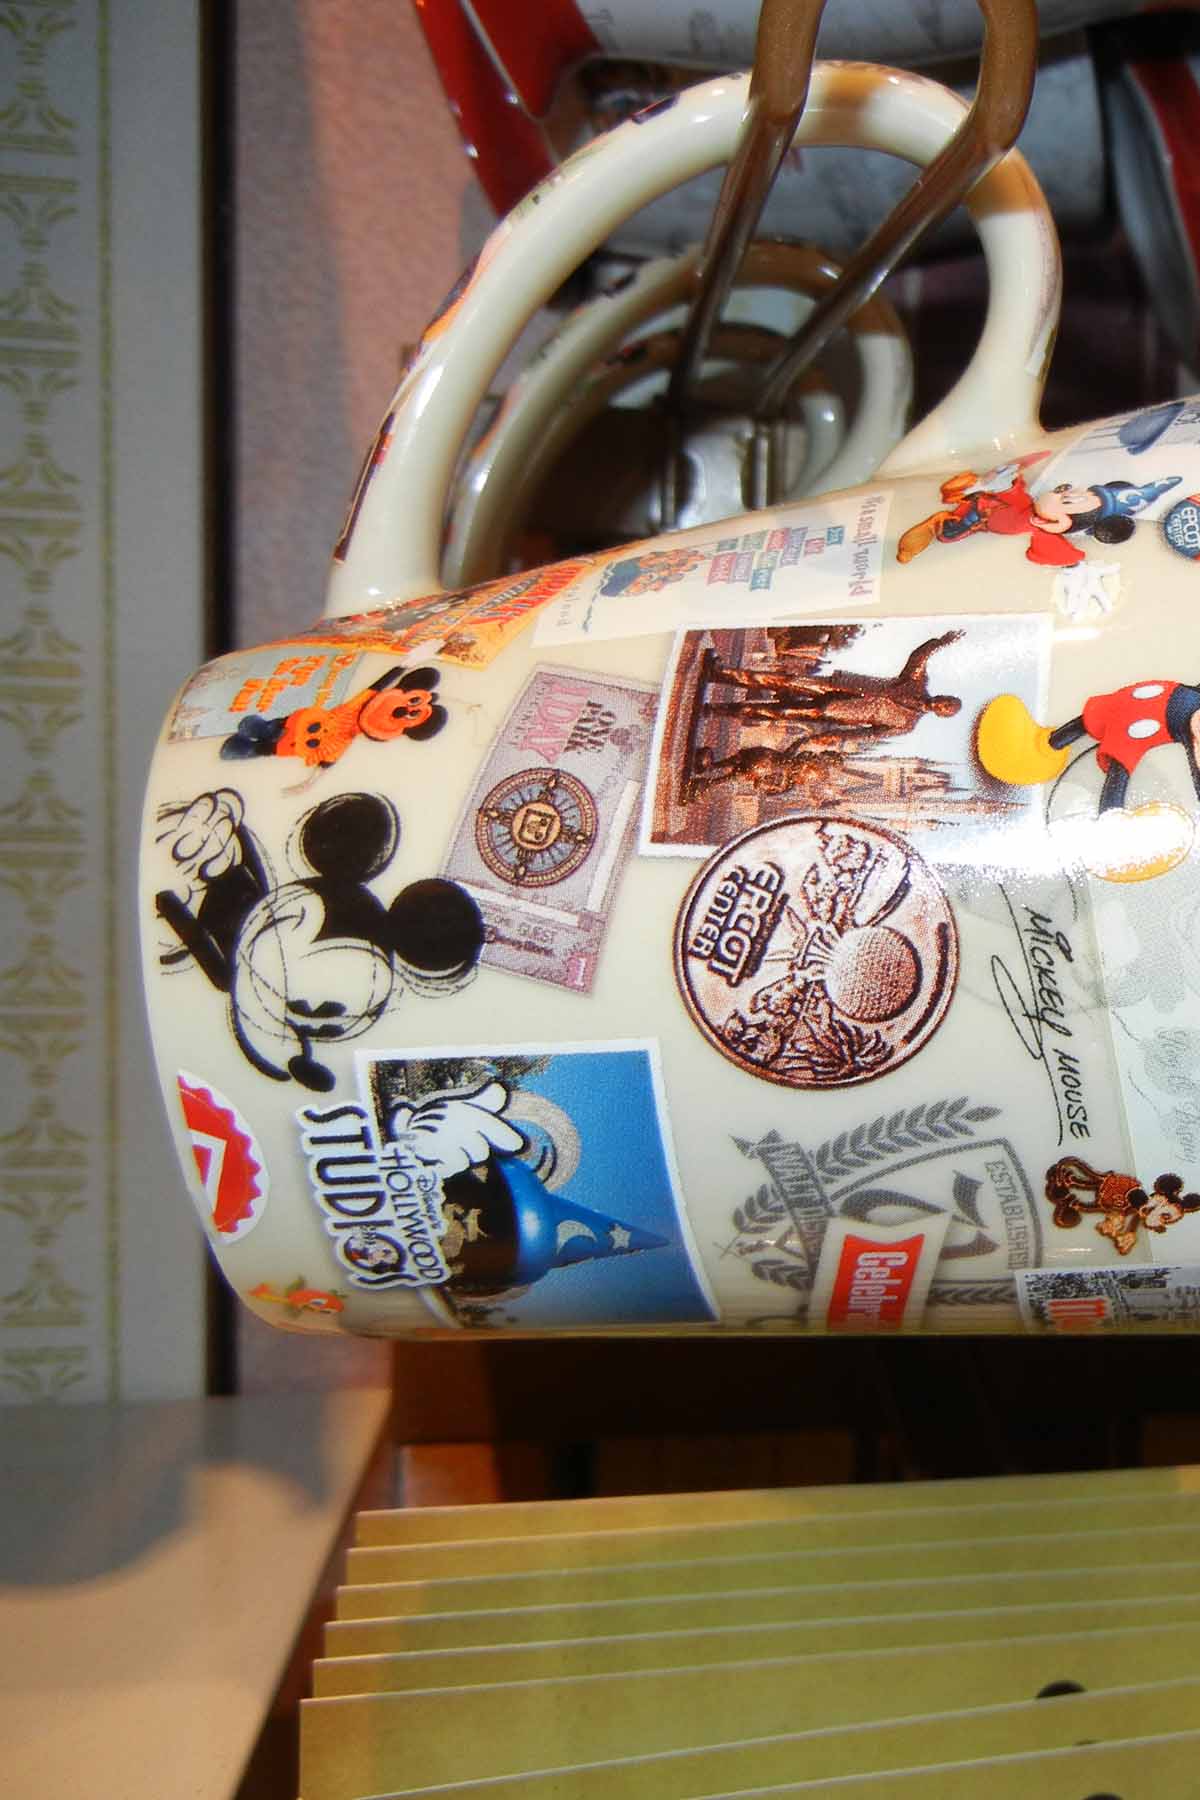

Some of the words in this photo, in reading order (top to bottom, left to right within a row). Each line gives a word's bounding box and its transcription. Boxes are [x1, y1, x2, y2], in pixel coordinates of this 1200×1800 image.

[1181, 507, 1200, 550] EPCOT
[689, 865, 749, 959] CENTER
[707, 861, 783, 986] EPCOT
[1053, 1048, 1091, 1138] MOUSE
[303, 1105, 418, 1287] STUDIOS
[379, 1147, 445, 1281] HOLLYWOOD
[984, 1160, 1029, 1270] ESTABLISHED
